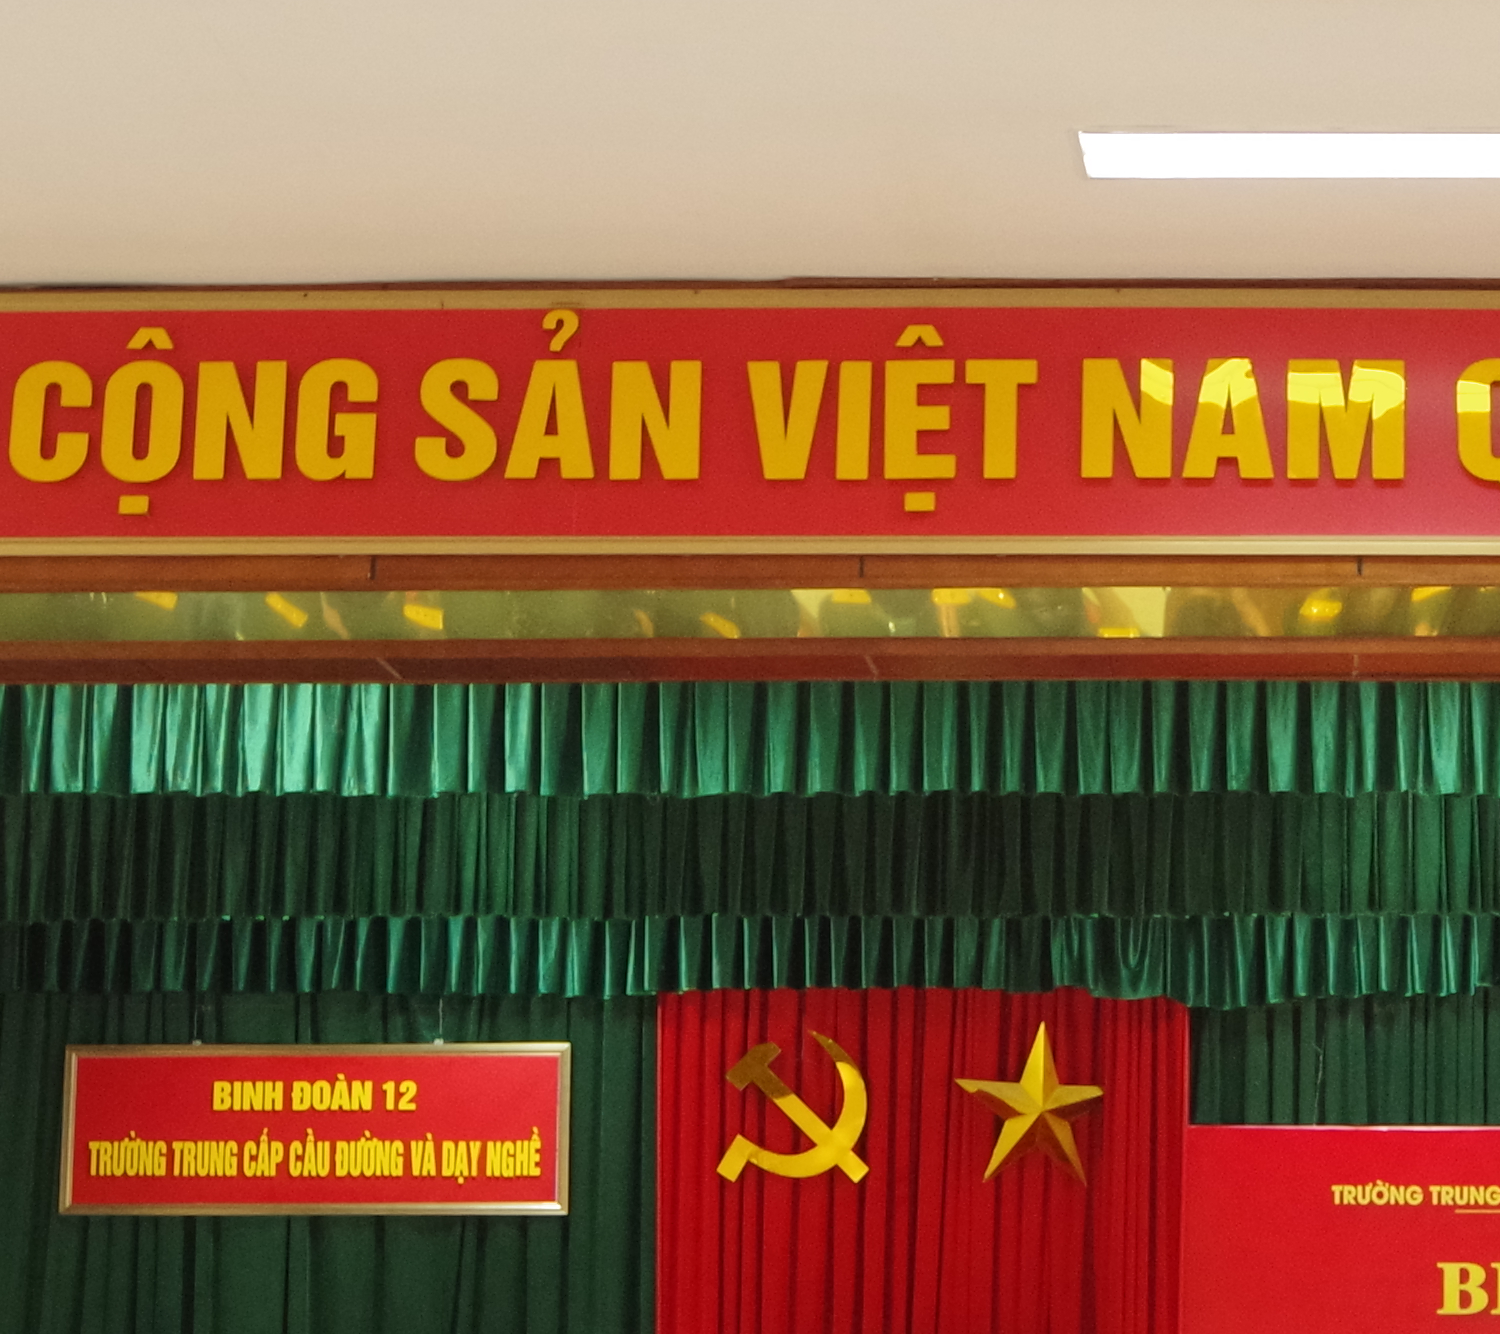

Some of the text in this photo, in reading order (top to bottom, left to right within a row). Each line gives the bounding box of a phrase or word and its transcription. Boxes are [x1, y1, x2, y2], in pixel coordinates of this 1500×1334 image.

[9, 328, 377, 514] CỘNG
[413, 309, 703, 481] SẢN
[748, 326, 1037, 511] VIỆT
[1082, 358, 1408, 479] NAM
[213, 1074, 417, 1110] BINH ĐOÀN 12
[89, 1127, 541, 1183] TRƯỜNG TRUNG CẤP CẦU ĐƯỜNG VÀ DẠY NGHỀ
[1332, 1180, 1423, 1205] TRƯỜNG
